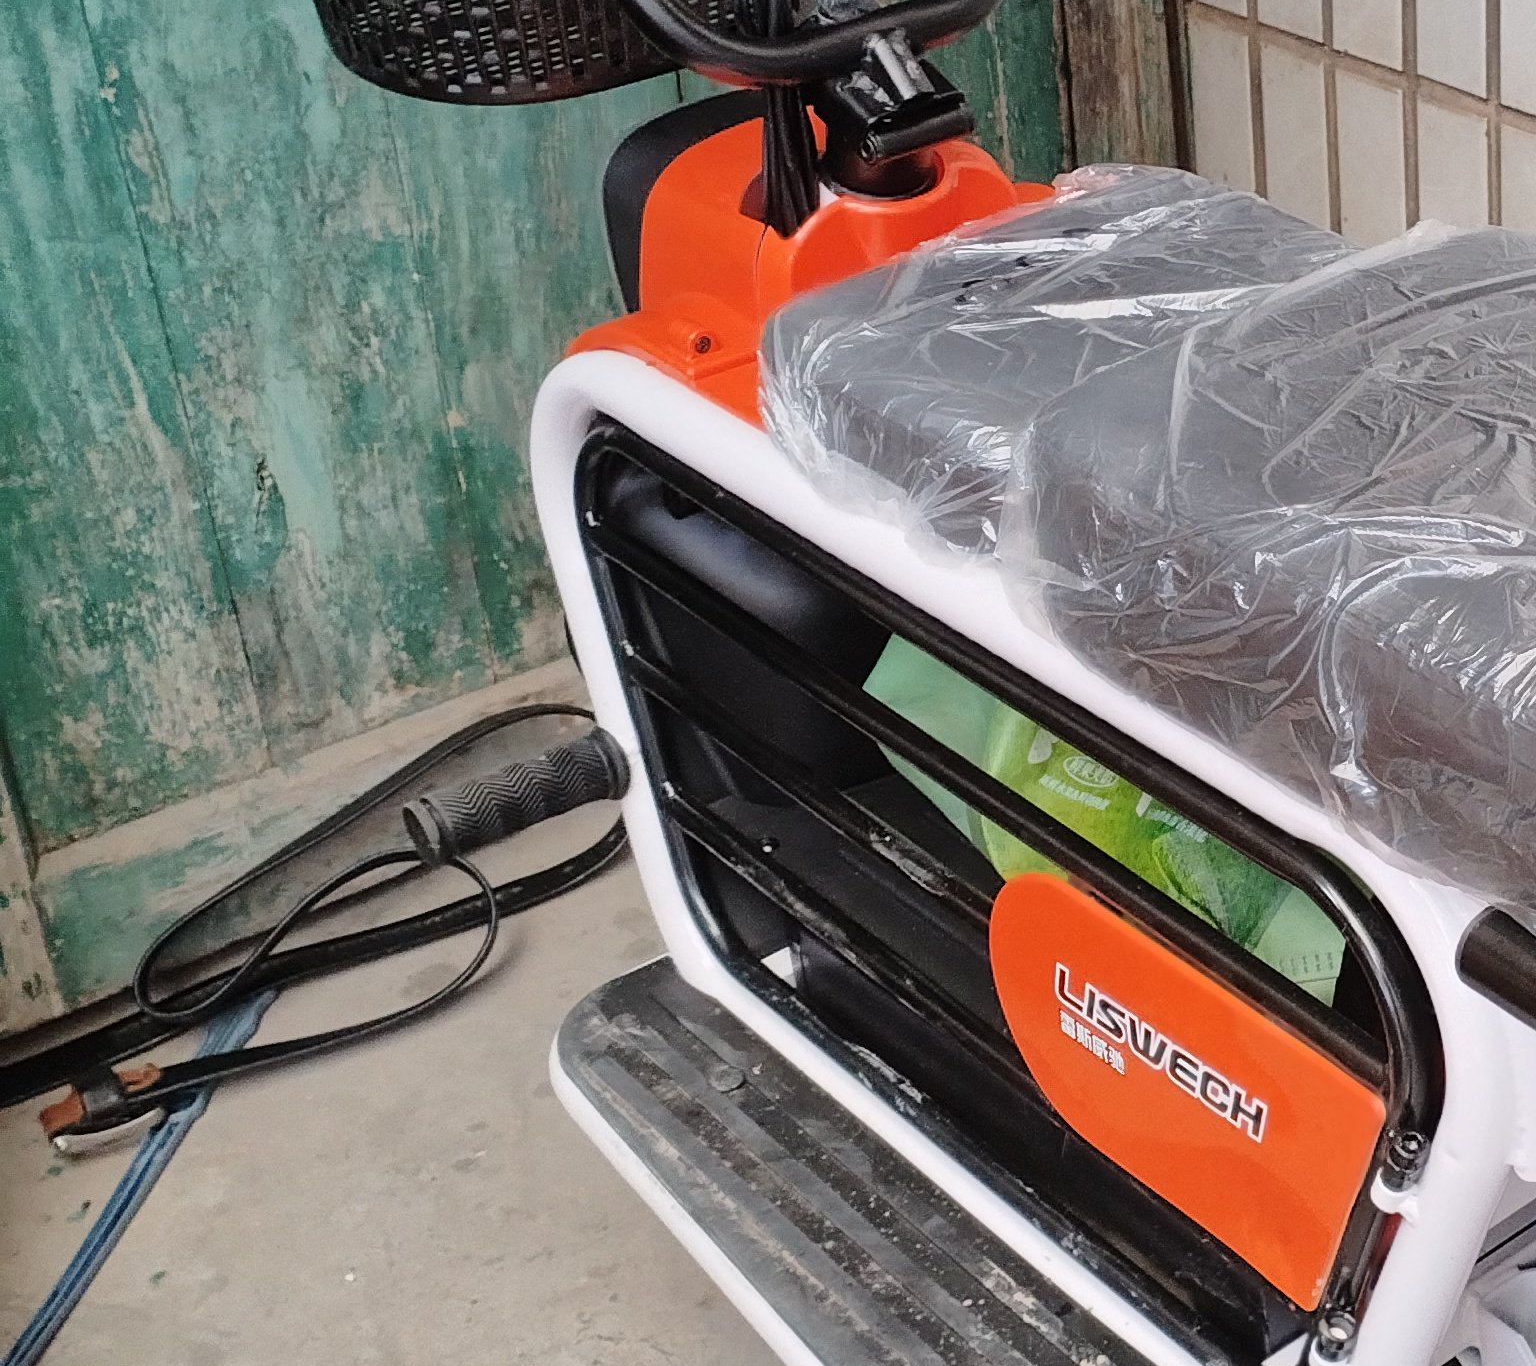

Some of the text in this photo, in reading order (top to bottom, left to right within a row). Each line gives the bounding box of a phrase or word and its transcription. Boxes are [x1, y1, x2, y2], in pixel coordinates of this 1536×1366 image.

[1055, 961, 1268, 1143] LISWECH
[1059, 1009, 1125, 1076] 雷斯威驰
